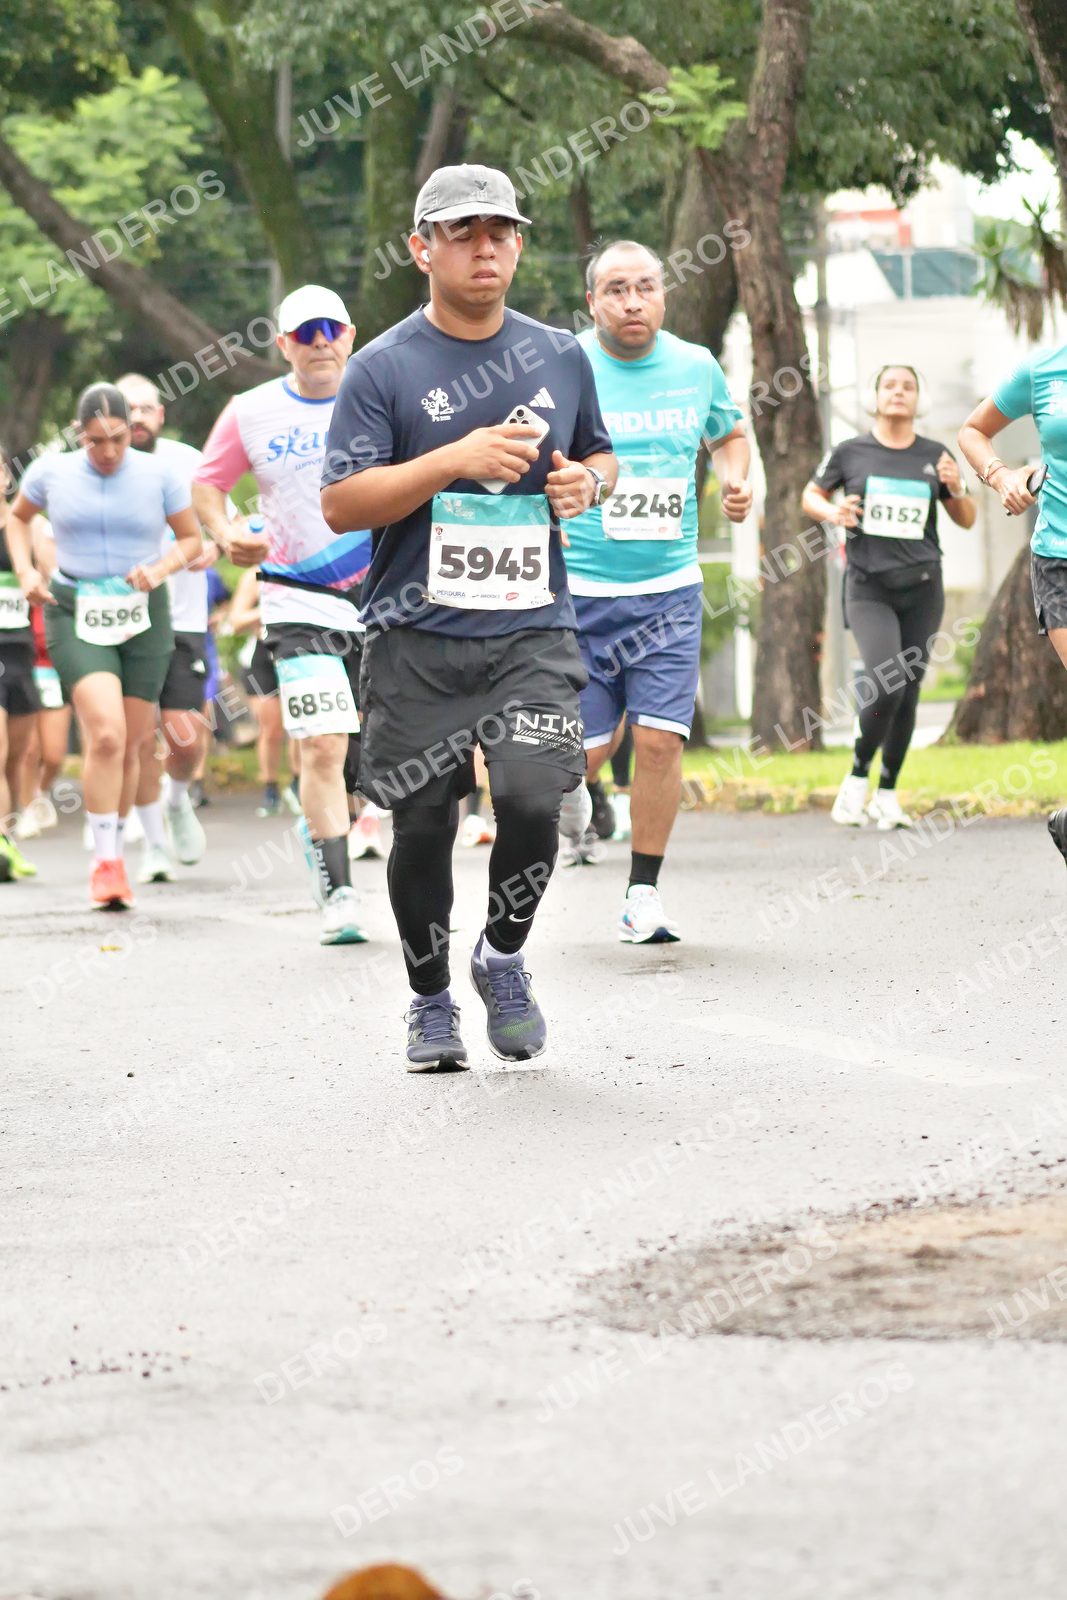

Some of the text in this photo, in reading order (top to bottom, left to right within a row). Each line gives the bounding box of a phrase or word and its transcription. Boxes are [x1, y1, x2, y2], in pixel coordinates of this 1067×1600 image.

[609, 493, 683, 518] 3248
[870, 504, 923, 525] 6152
[437, 544, 541, 582] 5945
[85, 606, 142, 628] 6596
[288, 692, 349, 719] 6856
